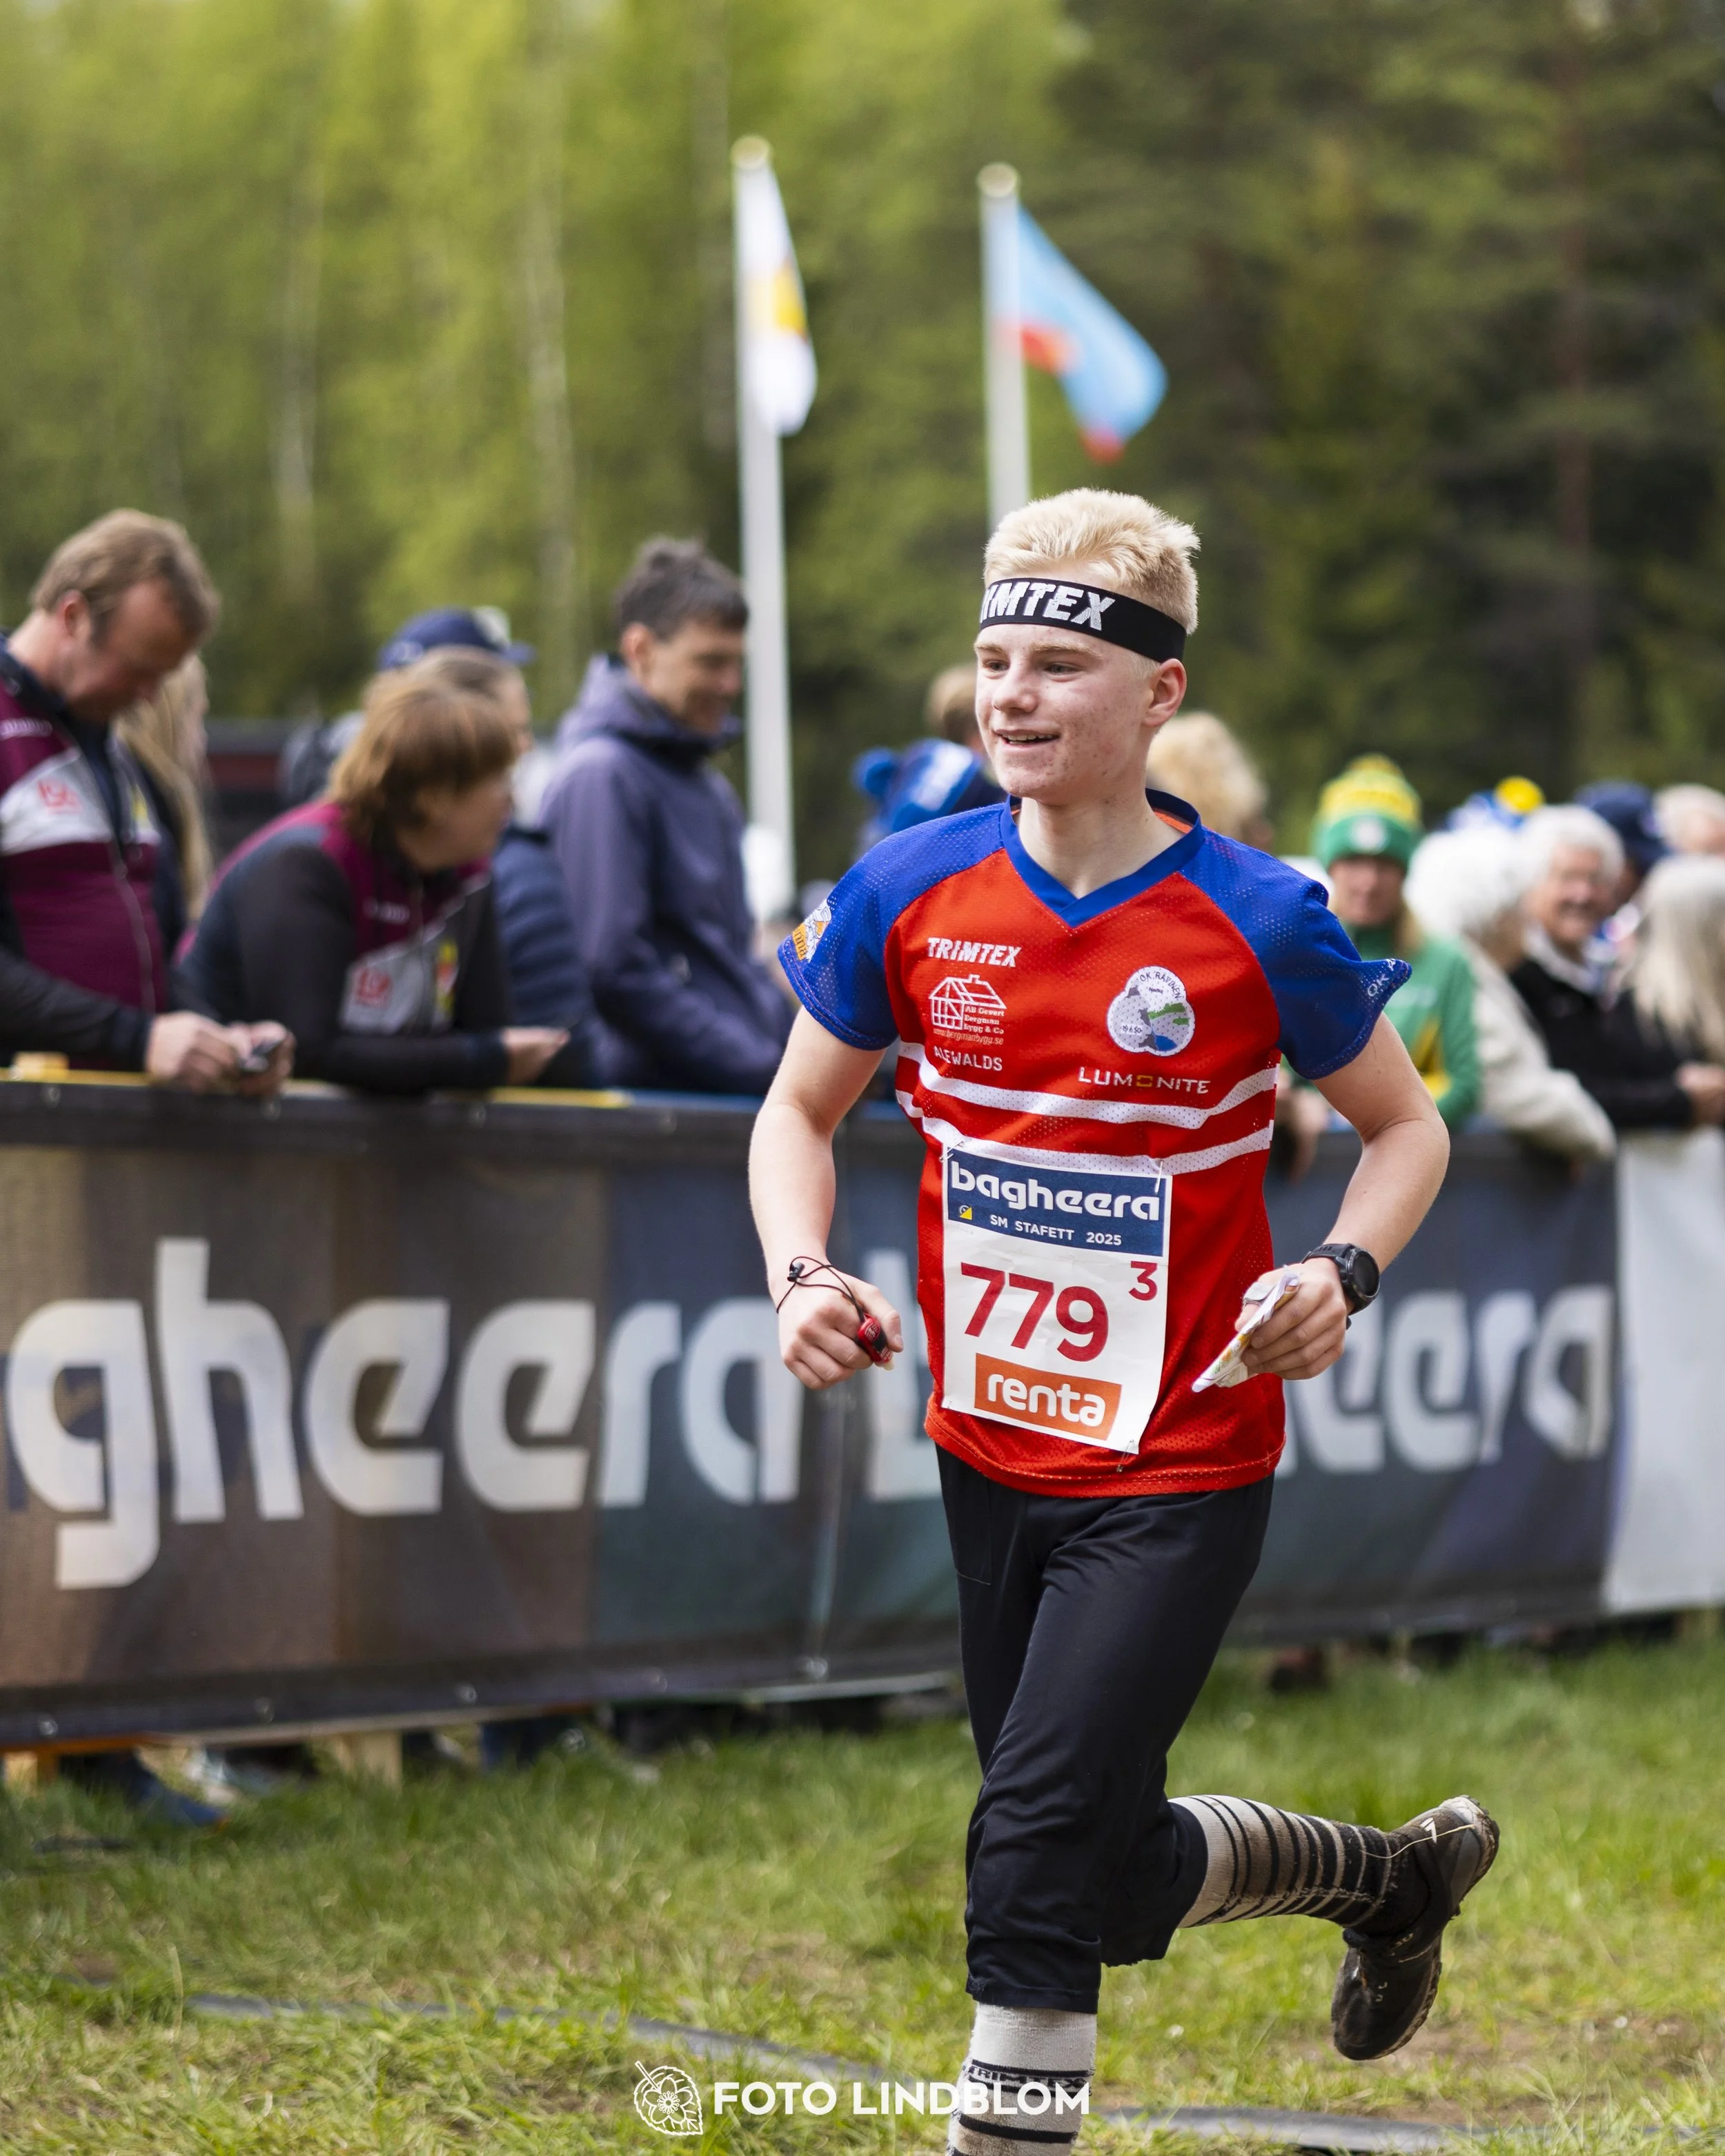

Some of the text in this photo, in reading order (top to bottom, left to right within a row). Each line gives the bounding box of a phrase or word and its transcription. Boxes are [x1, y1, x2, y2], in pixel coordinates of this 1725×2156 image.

[927, 937, 1021, 968] TRIMTEX
[964, 1015, 1000, 1025] Bergman
[964, 1024, 983, 1034] Bygg
[934, 1045, 1003, 1071] ALEWALDS
[1078, 1067, 1212, 1094] LUMONITE
[951, 1160, 1161, 1221] bagheera
[990, 1214, 1123, 1246] SM STAFETT 2025
[1128, 1260, 1159, 1301] 3
[960, 1262, 1110, 1362] 779
[987, 1373, 1106, 1427] renta
